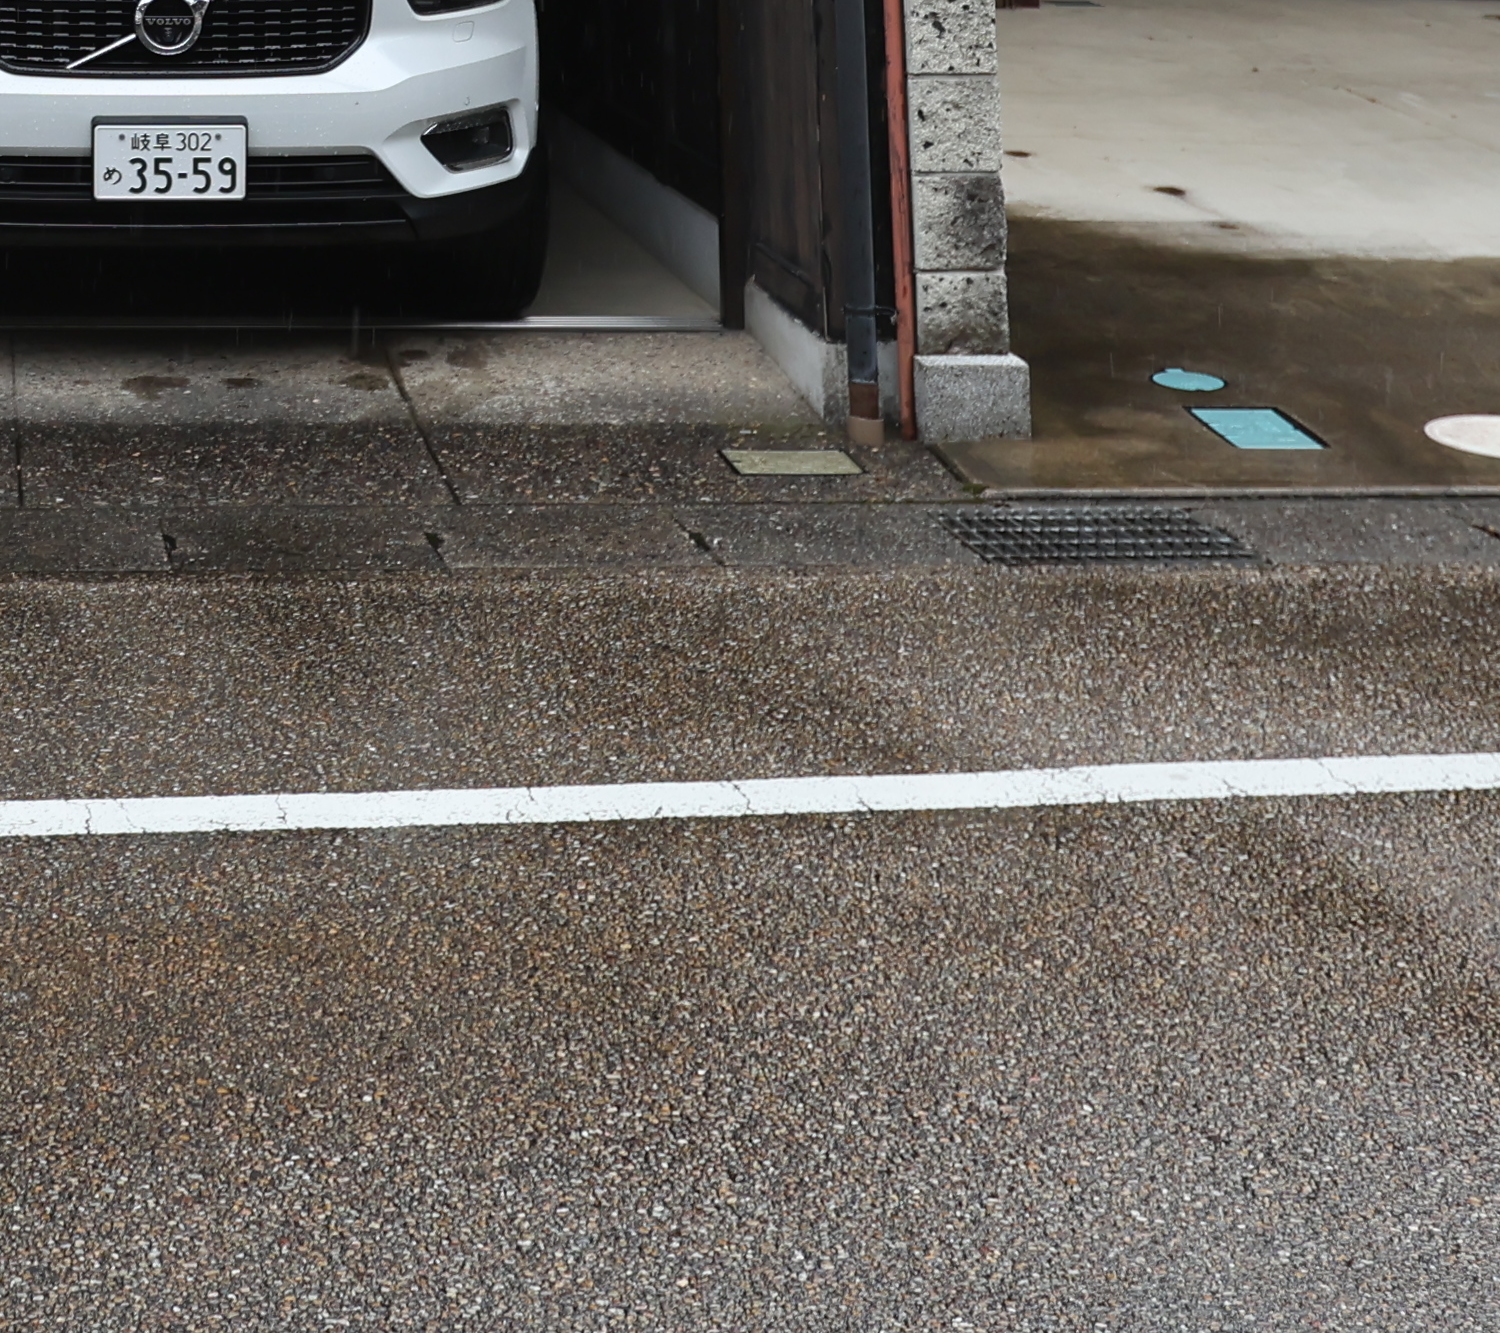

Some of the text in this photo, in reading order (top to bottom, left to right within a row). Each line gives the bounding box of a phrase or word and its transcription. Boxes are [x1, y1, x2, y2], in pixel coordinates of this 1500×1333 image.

[145, 18, 192, 26] VOLVO
[103, 156, 237, 194] め 35-59
